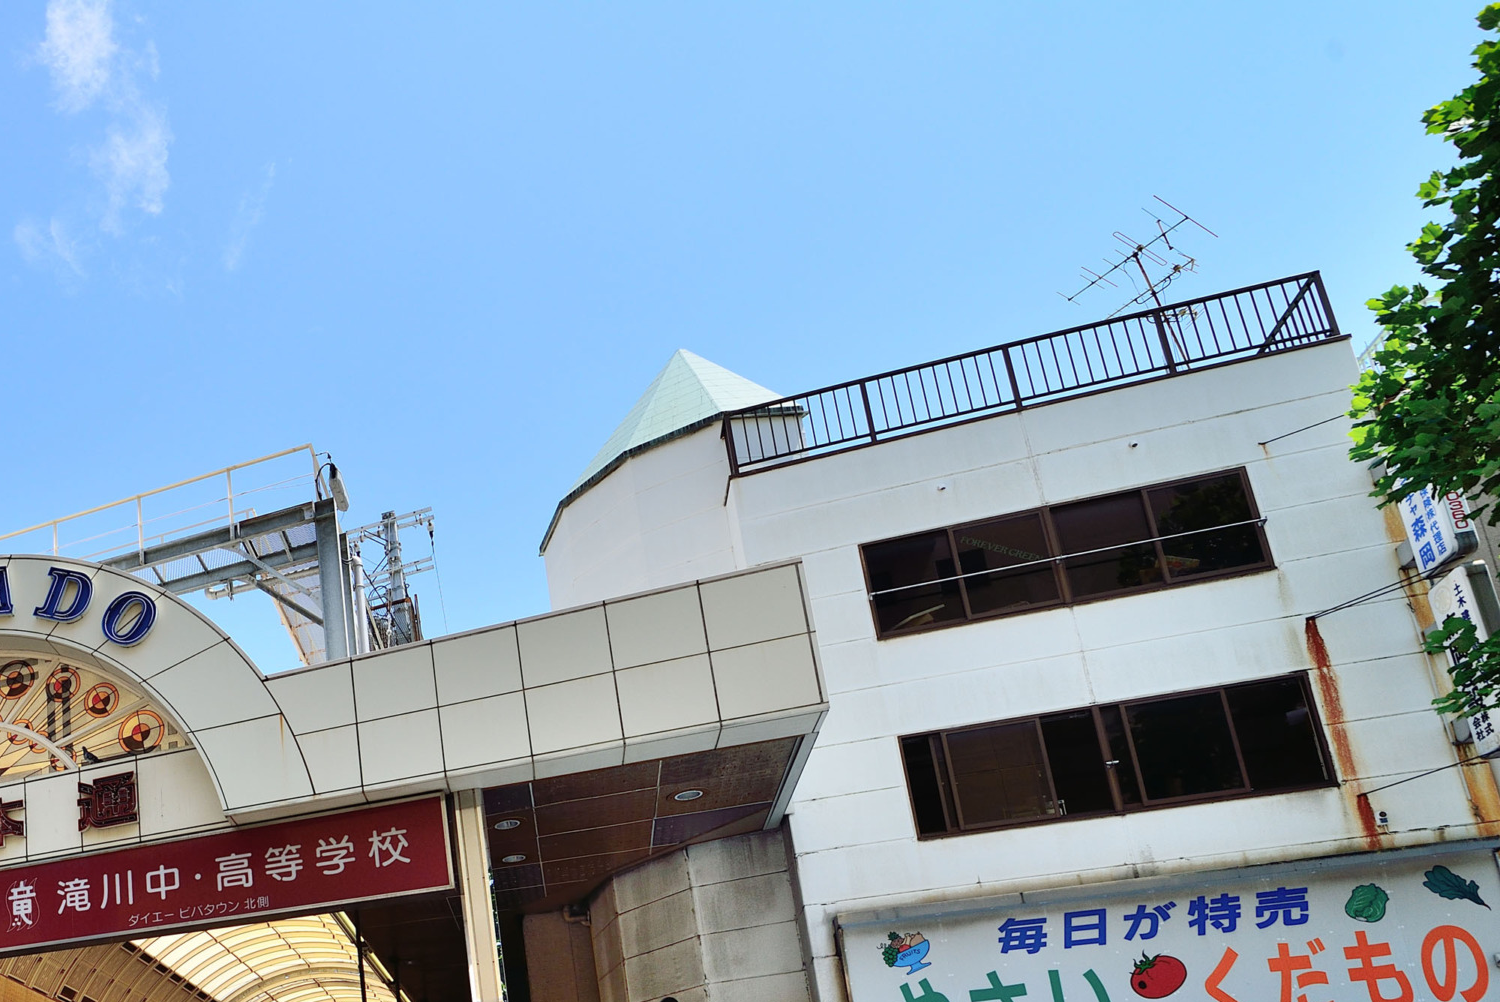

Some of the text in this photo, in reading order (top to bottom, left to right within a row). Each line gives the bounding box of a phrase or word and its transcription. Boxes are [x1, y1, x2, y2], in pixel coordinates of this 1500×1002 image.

[960, 536, 1044, 561] FOREVER GREEN
[56, 826, 412, 916] 滝川中・高等学校
[128, 896, 269, 928] ダイエー ビバタウン 北側
[998, 886, 1310, 955] 毎日が特売
[899, 948, 921, 961] FRUITS
